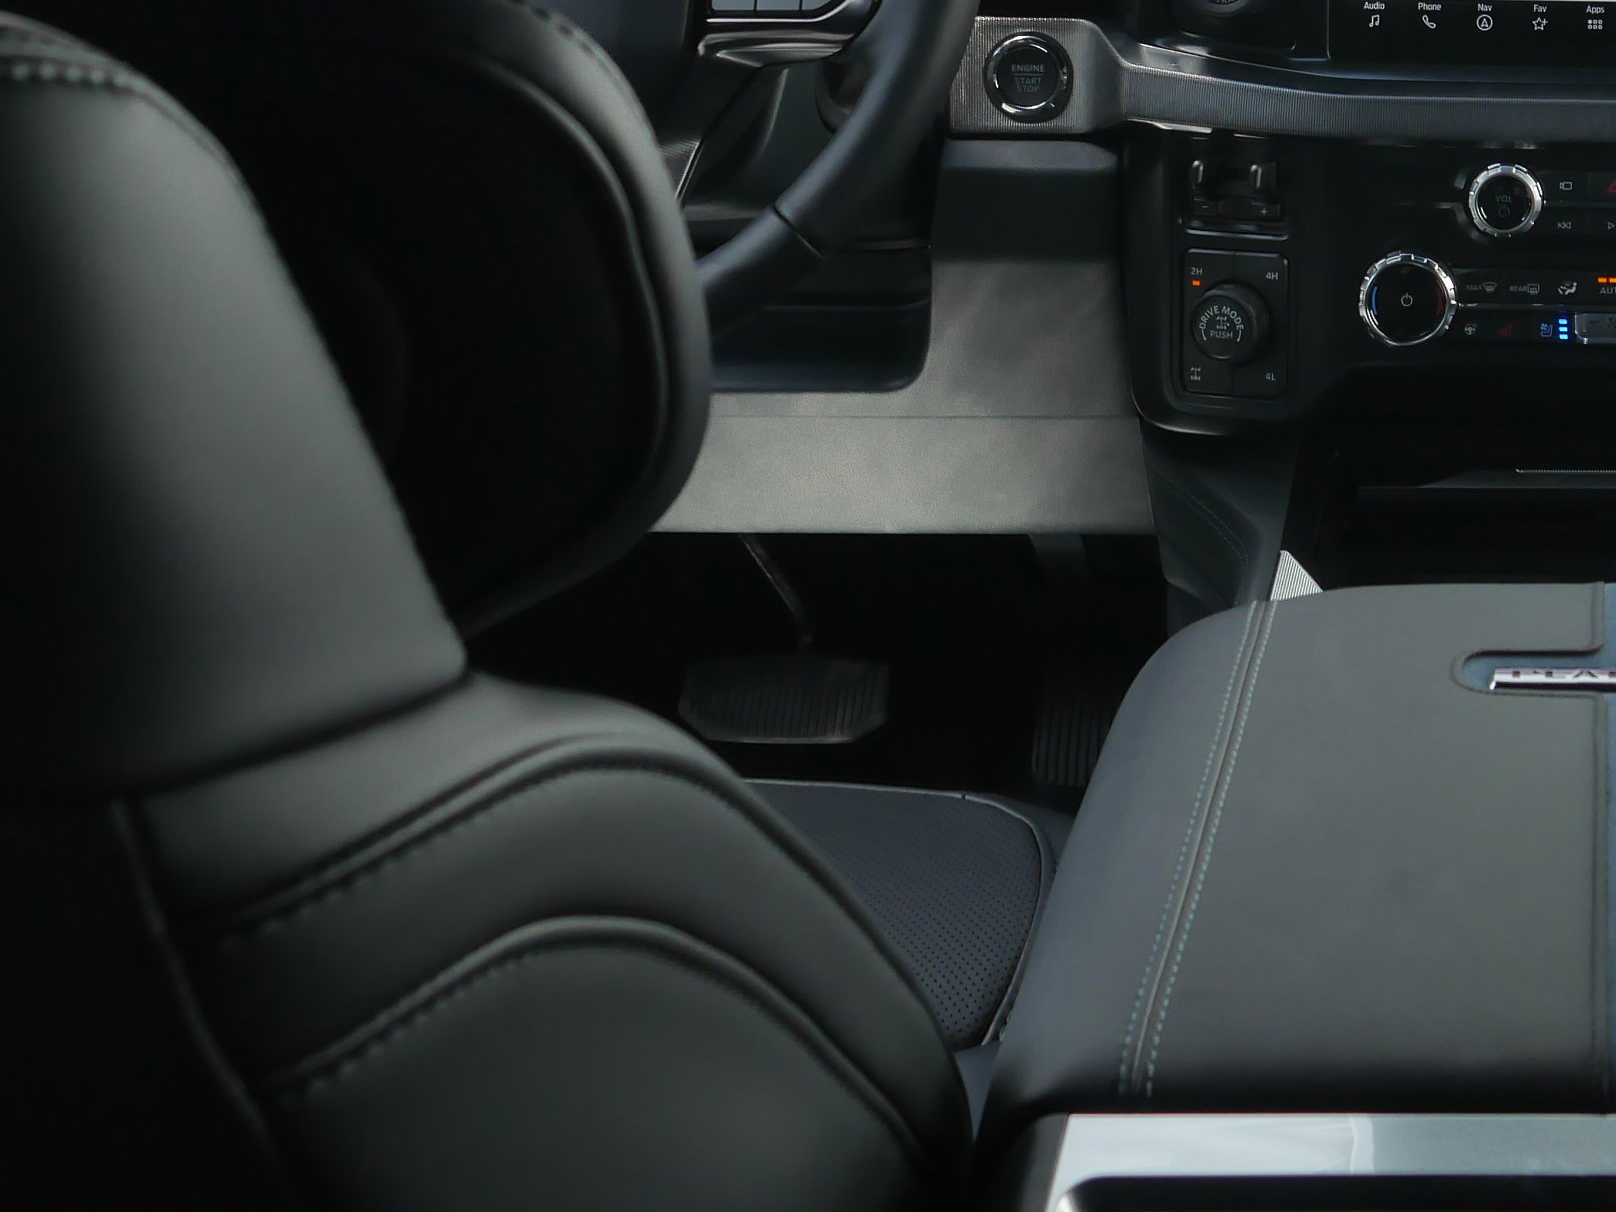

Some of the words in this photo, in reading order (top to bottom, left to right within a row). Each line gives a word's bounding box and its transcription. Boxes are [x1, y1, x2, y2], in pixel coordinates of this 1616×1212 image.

[1363, 1, 1386, 11] Audio
[1417, 2, 1442, 12] Phone
[1477, 3, 1493, 12] Nav
[1533, 4, 1547, 13] Fav
[1586, 5, 1605, 15] Apps
[1011, 64, 1045, 73] ENGINE
[1014, 77, 1042, 85] START
[1016, 85, 1040, 93] STOP
[1190, 267, 1203, 276] 2H
[1265, 271, 1279, 281] 4H
[1198, 305, 1220, 330] DRIVE
[1221, 306, 1245, 331] MODE
[1210, 330, 1234, 340] PUSH
[1265, 372, 1277, 381] 4L
